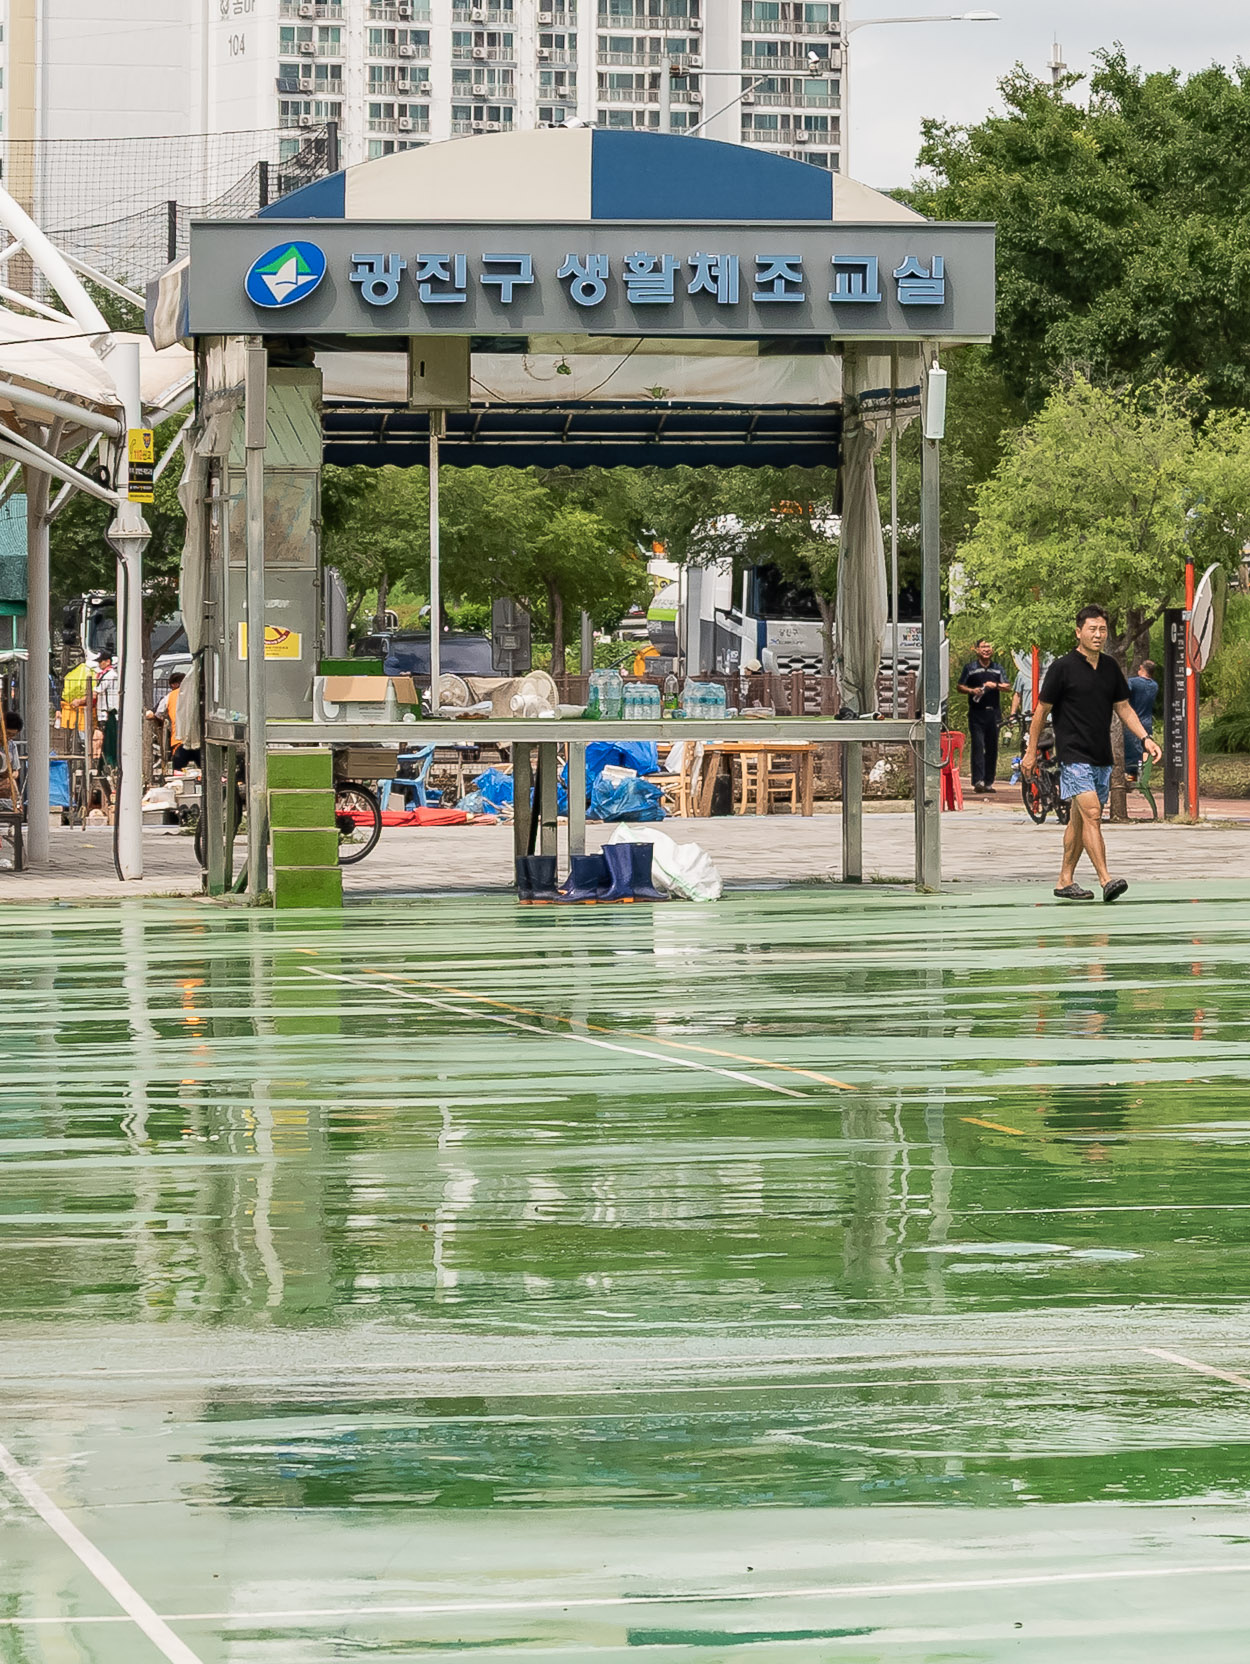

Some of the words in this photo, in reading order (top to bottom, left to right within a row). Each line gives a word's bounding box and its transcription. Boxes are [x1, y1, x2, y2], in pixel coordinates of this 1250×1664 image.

[228, 33, 245, 57] 104
[349, 252, 534, 306] 광진구
[556, 250, 806, 307] 생활체조
[828, 254, 946, 306] 교실
